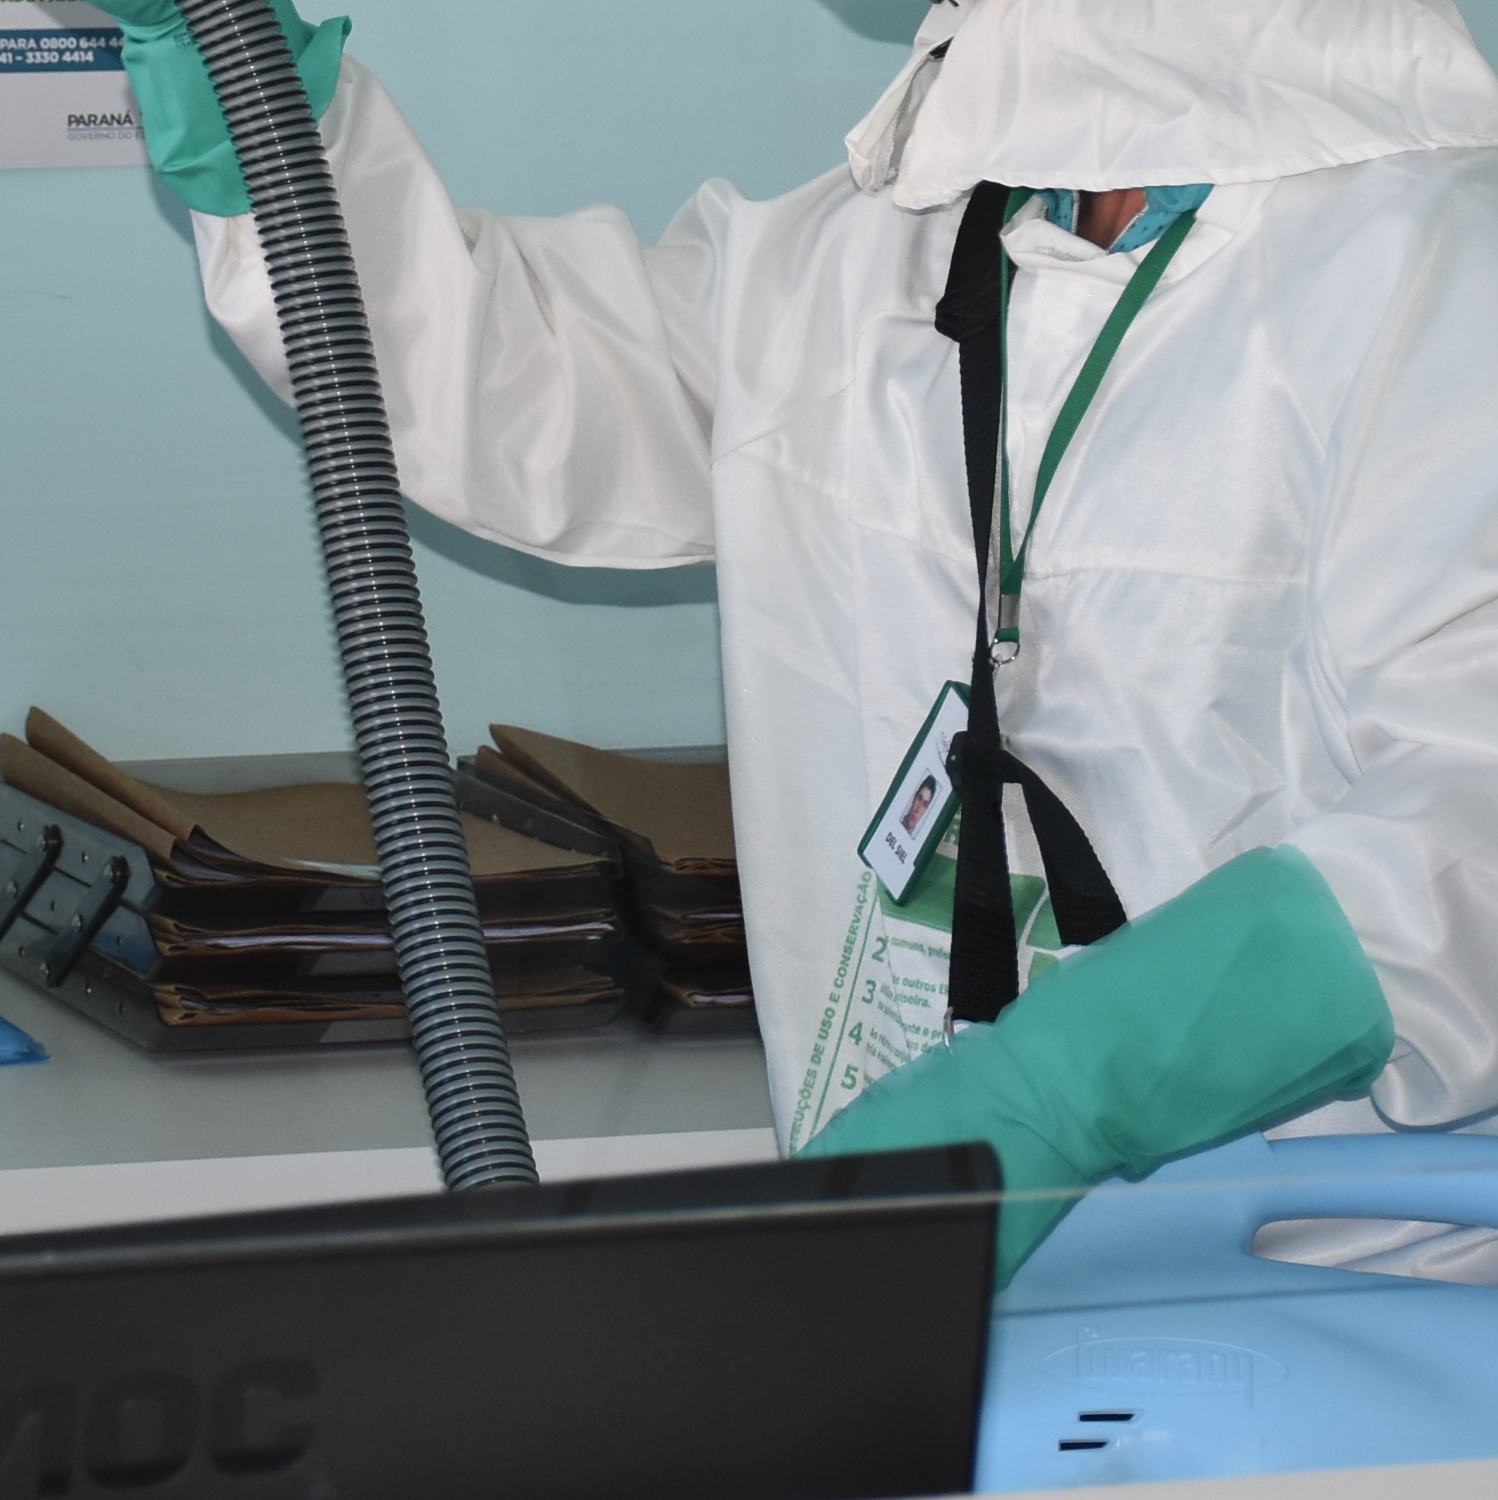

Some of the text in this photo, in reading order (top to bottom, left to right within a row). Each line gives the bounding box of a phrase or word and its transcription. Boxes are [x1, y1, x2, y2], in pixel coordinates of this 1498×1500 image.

[0, 37, 37, 50] PARA
[39, 37, 77, 50] 0800
[62, 50, 94, 63] 4414
[67, 108, 134, 127] PARANÁ
[834, 869, 874, 990] CONSERVAÇÃO
[871, 935, 889, 963] 2
[861, 979, 877, 1005] 3
[902, 977, 937, 994] outros
[829, 991, 841, 1005] E
[817, 1006, 836, 1041] USO
[848, 1021, 864, 1046] 4
[811, 1043, 825, 1066] DE
[840, 1063, 859, 1091] 5
